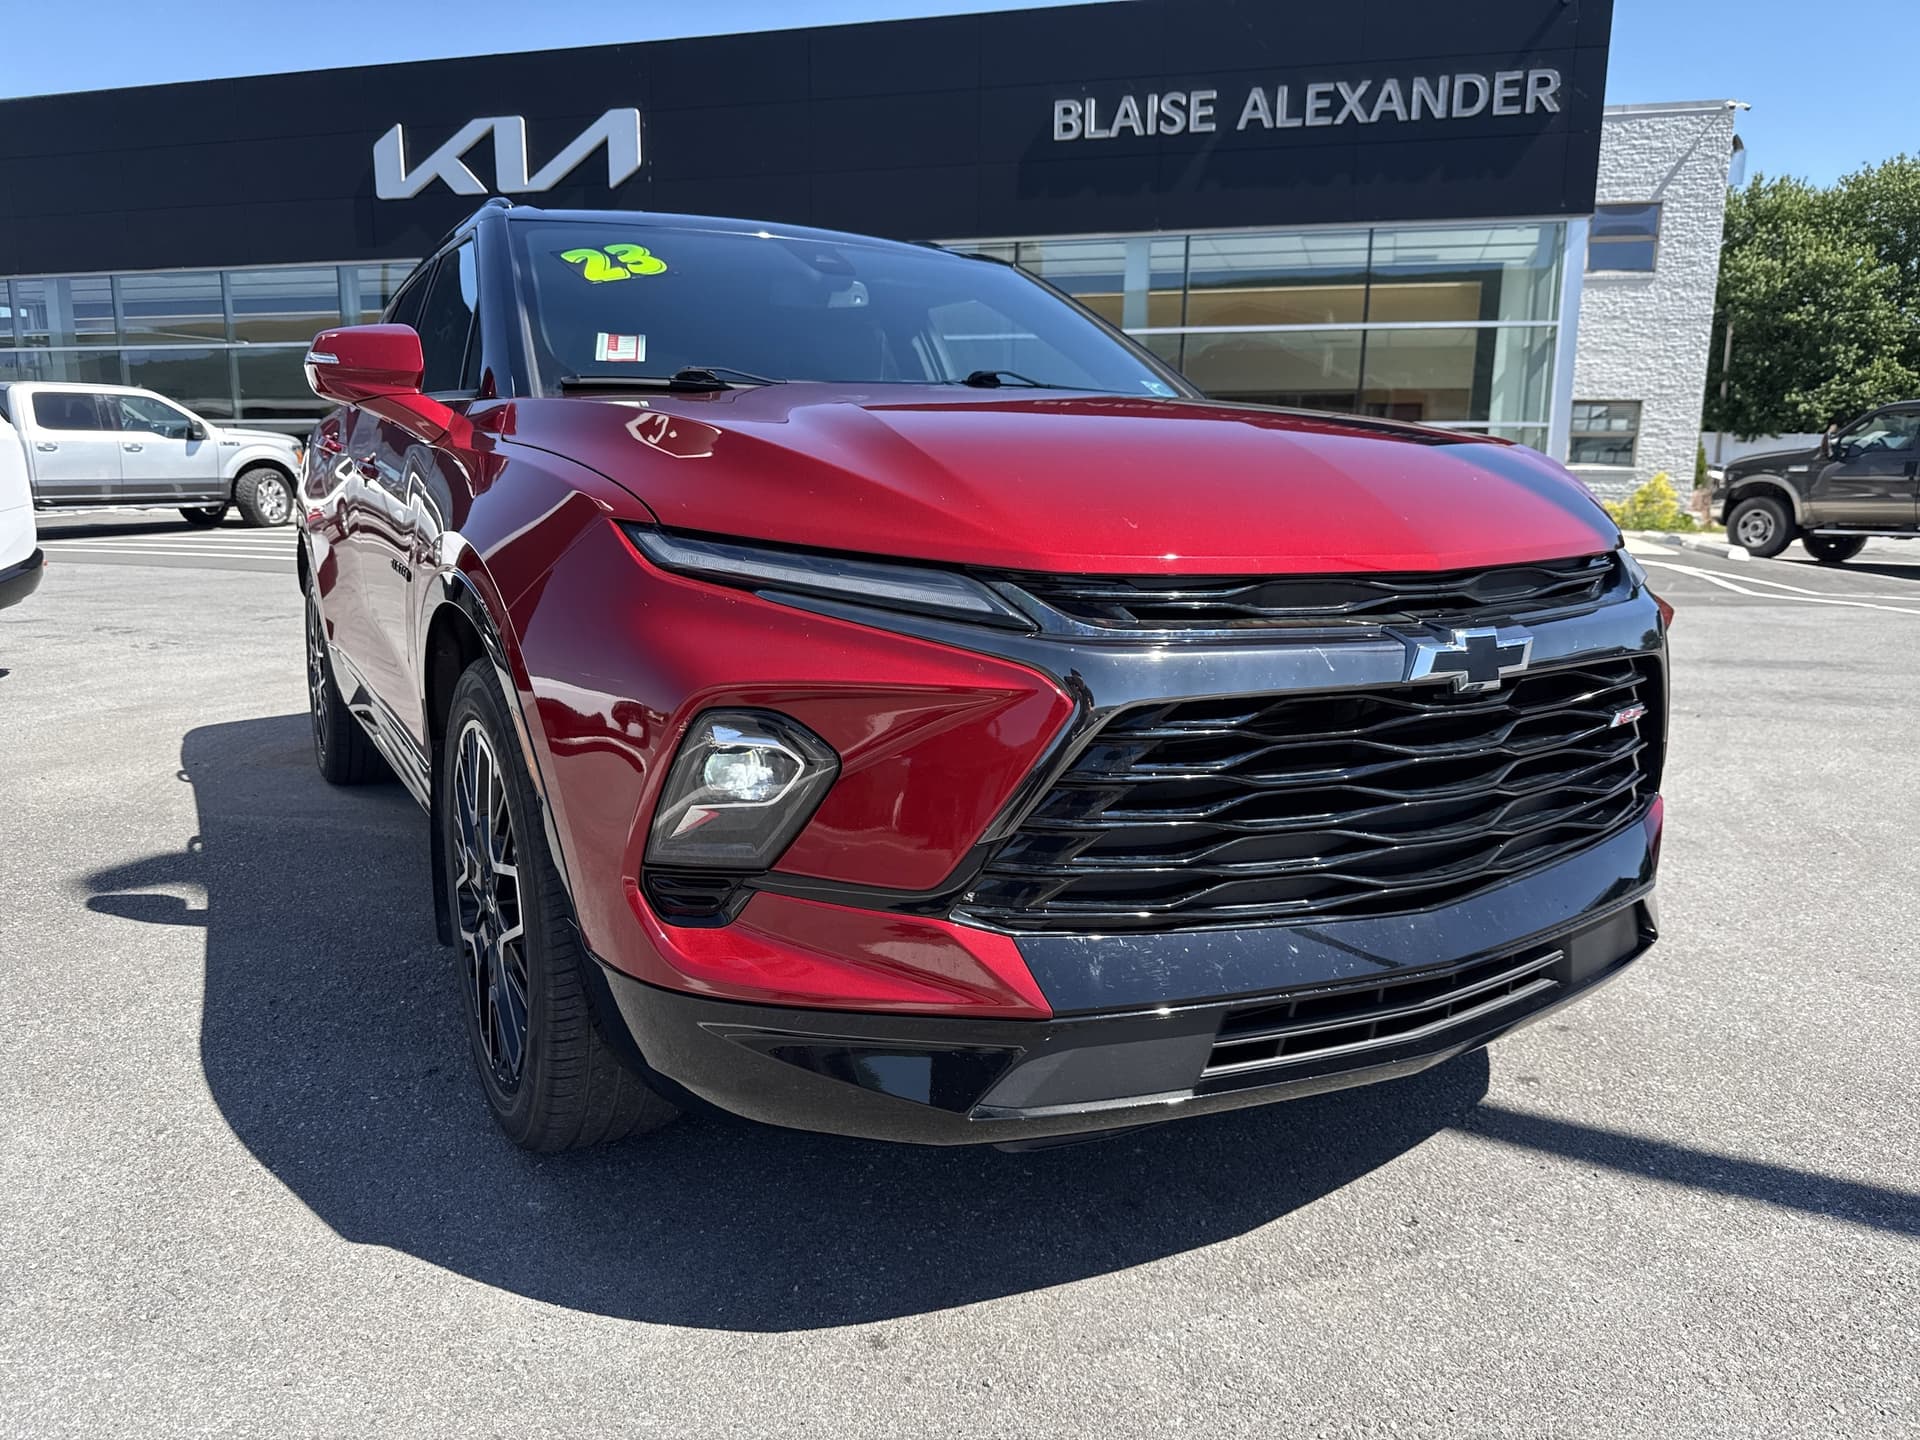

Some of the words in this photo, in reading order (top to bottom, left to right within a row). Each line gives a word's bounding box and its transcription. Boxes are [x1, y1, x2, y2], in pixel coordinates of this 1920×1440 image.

[1053, 90, 1217, 141] BLAISE
[1236, 68, 1562, 131] ALEXANDER
[560, 243, 668, 284] 23
